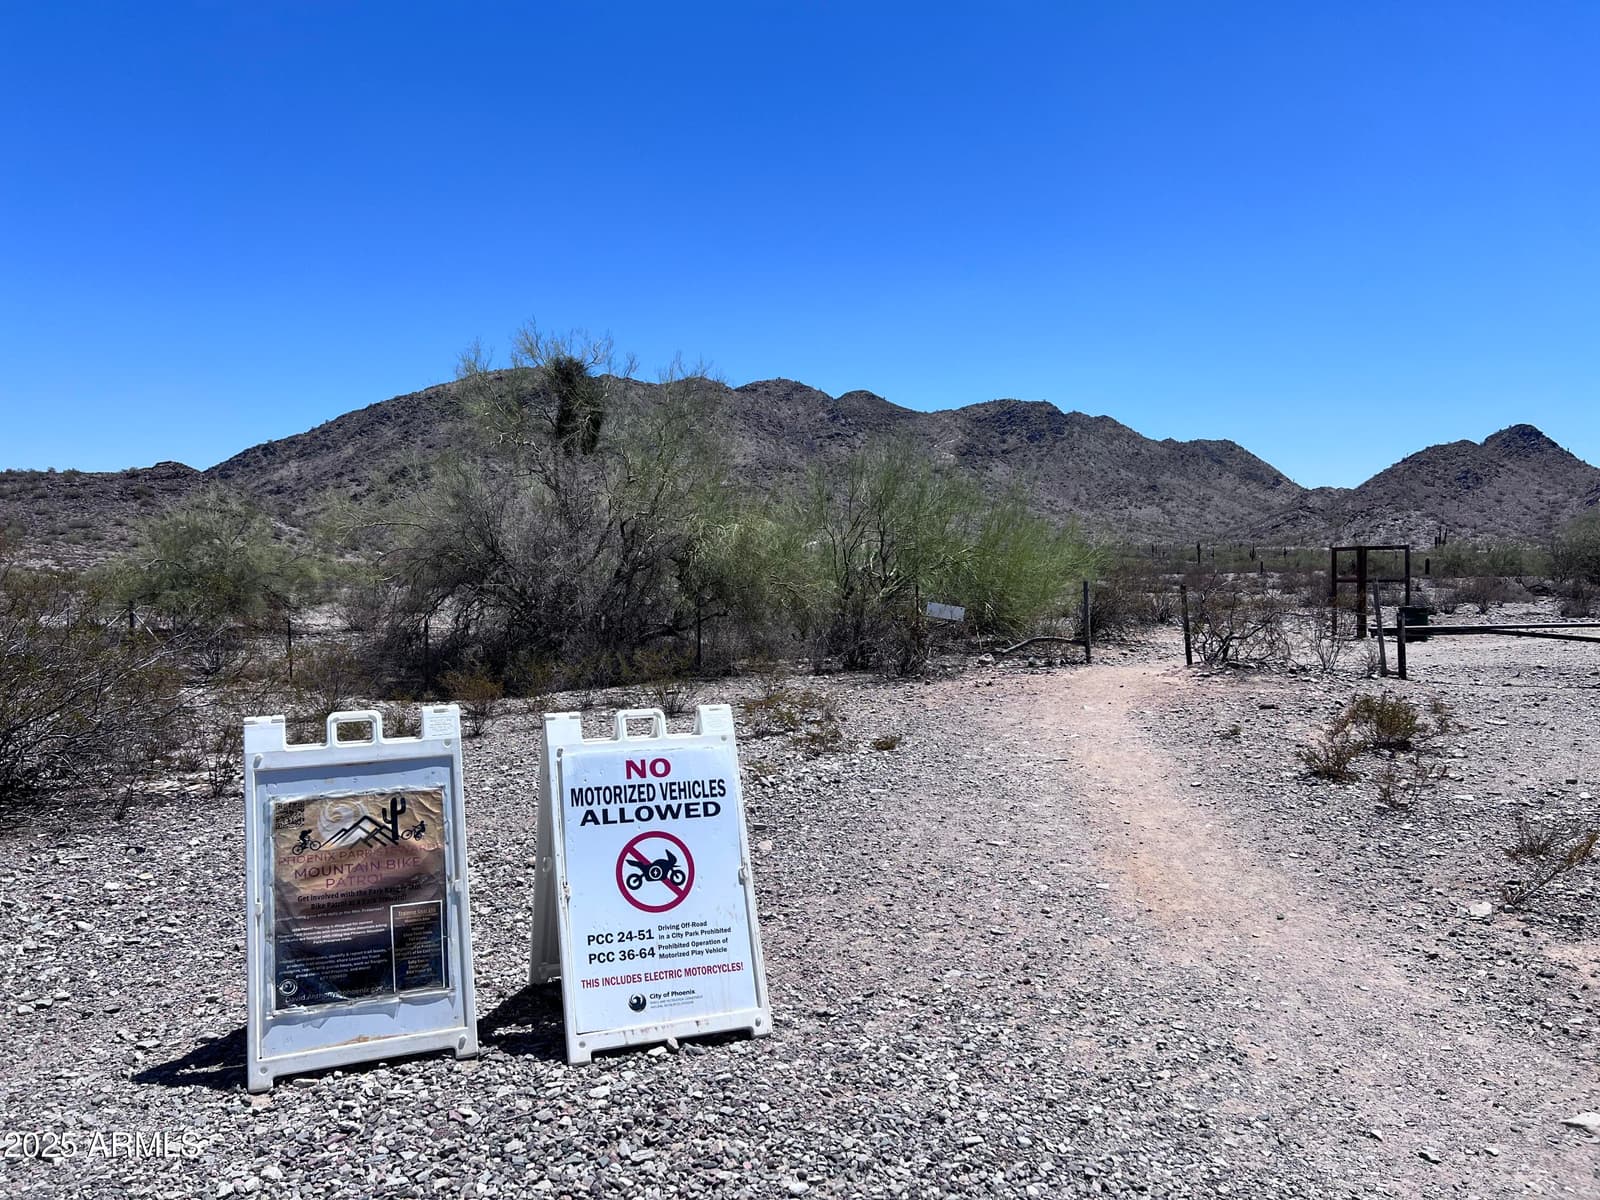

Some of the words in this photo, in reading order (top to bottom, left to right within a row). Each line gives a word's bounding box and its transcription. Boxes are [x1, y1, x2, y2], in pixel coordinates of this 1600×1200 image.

[625, 757, 671, 780] NO
[570, 783, 656, 808] MOTORIZED
[659, 778, 727, 801] VEHICLES
[580, 801, 721, 827] ALLOWED
[278, 853, 335, 866] PHOENIX
[294, 861, 381, 880] MOUNTAIN
[386, 857, 422, 872] BIKE
[657, 923, 680, 931] Driving
[680, 920, 708, 929] Off-Road
[684, 929, 700, 937] Park
[700, 926, 732, 935] Prohibited
[587, 933, 614, 946] PCC
[617, 928, 654, 943] 24-51
[657, 941, 690, 951] Prohibited
[690, 938, 721, 947] Operation
[588, 951, 615, 964] PCC
[620, 947, 656, 961] 36-64
[658, 950, 690, 960] Motorized
[690, 948, 704, 957] Play
[704, 946, 728, 955] Vehicle
[581, 978, 600, 989] THIS
[602, 973, 642, 987] INCLUDES
[644, 969, 682, 982] ELECTRIC
[684, 961, 744, 977] MOTORCYCLES!
[670, 988, 695, 997] Phoenix
